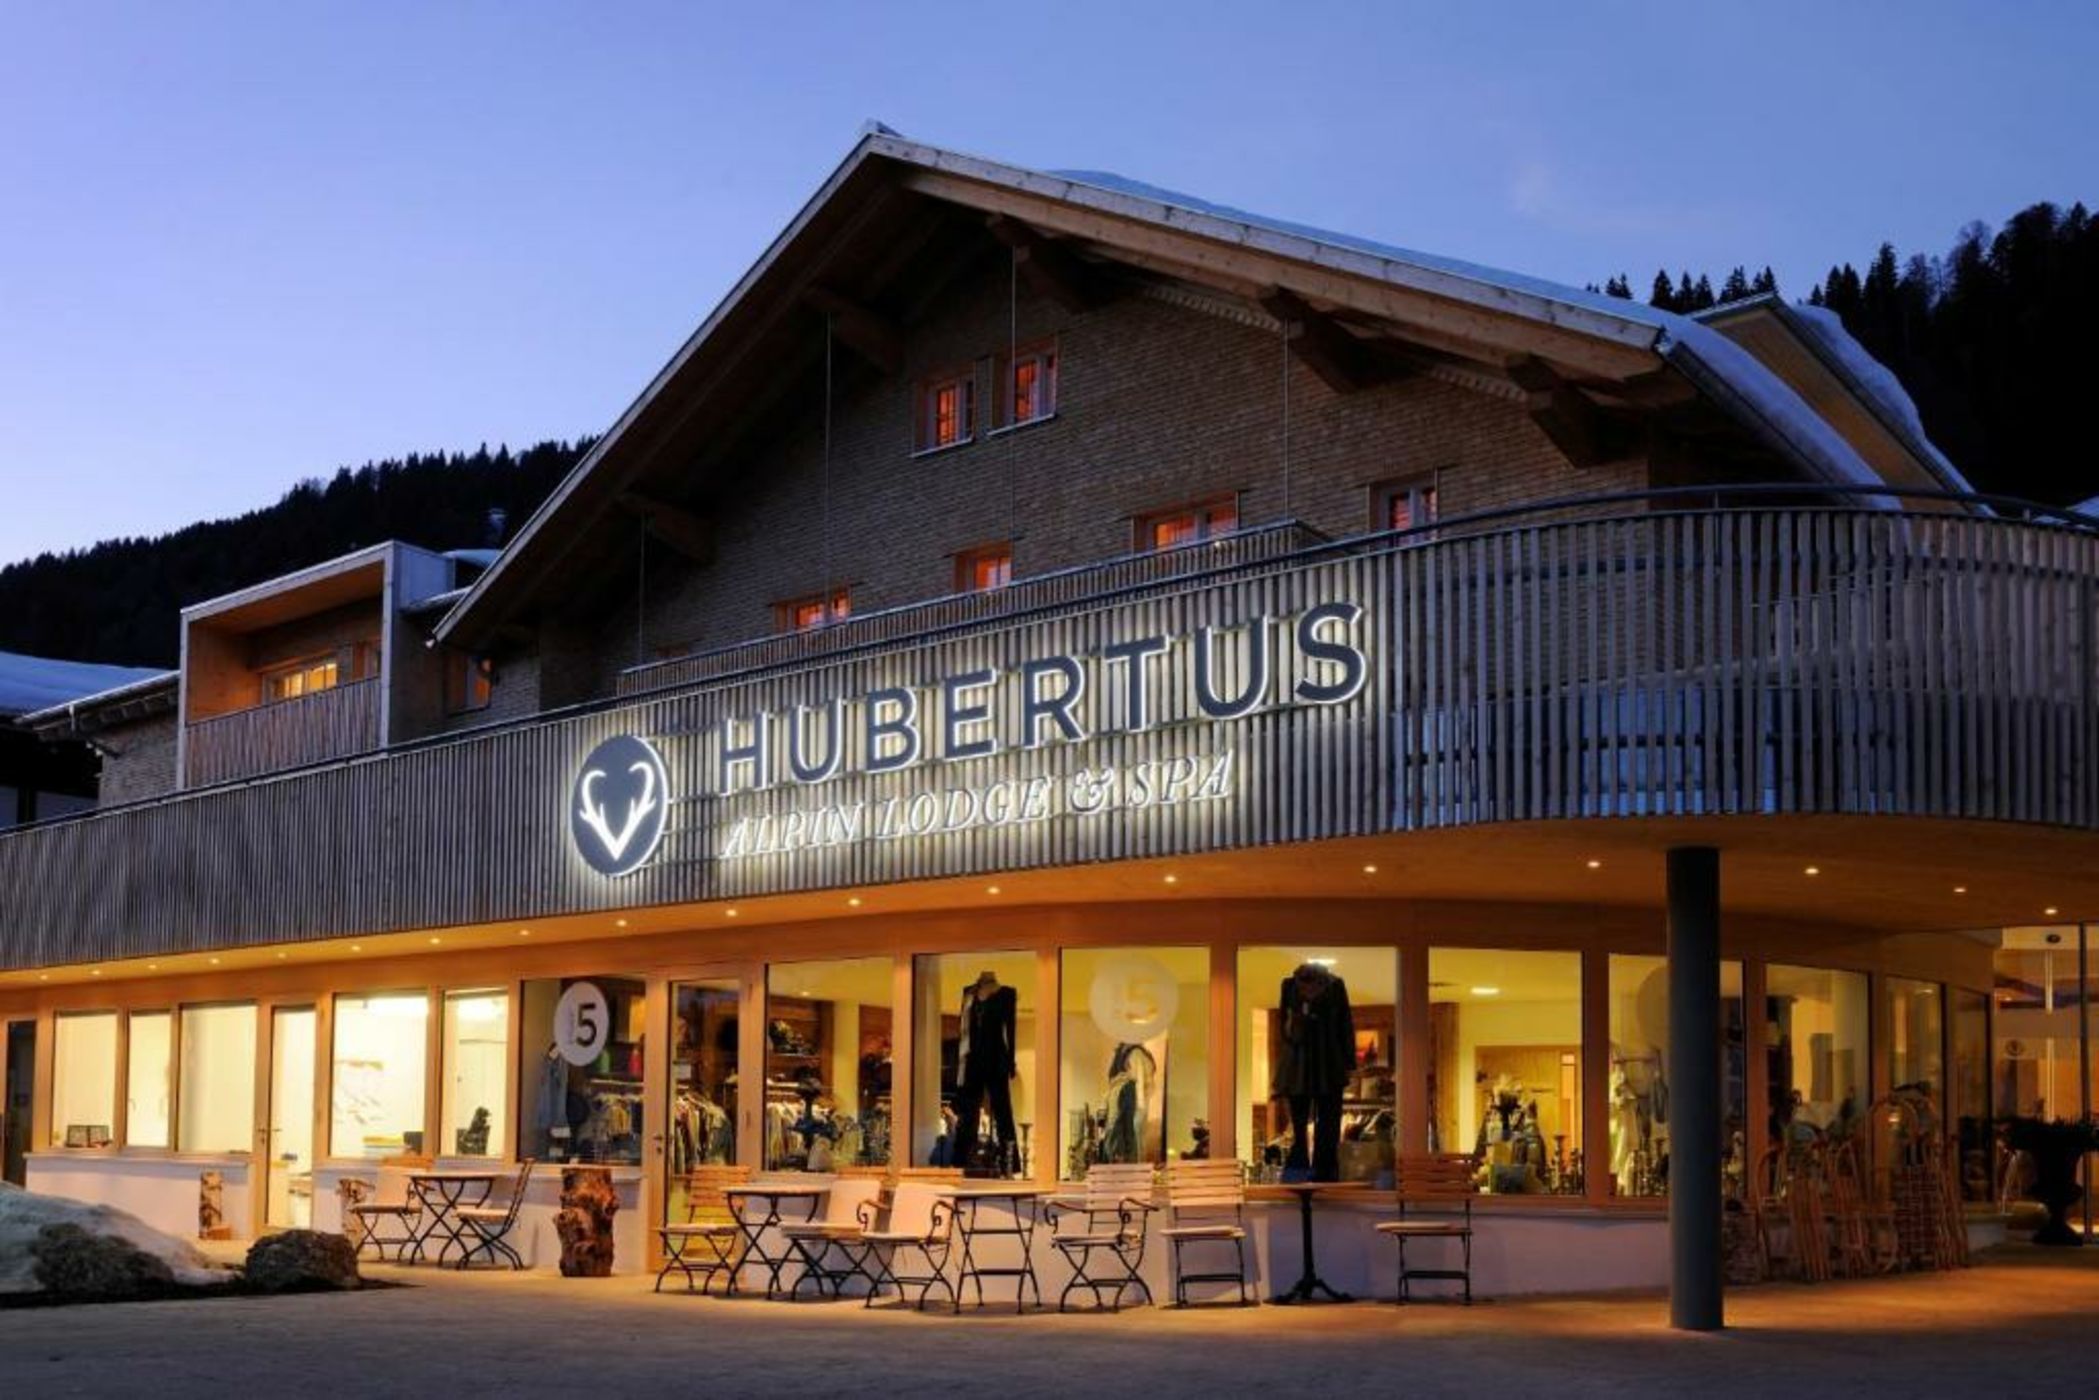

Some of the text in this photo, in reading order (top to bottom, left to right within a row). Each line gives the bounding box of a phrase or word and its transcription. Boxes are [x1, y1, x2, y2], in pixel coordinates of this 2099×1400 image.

[718, 601, 1369, 796] HUBERTUS
[718, 749, 1232, 859] ALPIN LODGE & SPA
[576, 1003, 597, 1047] 5
